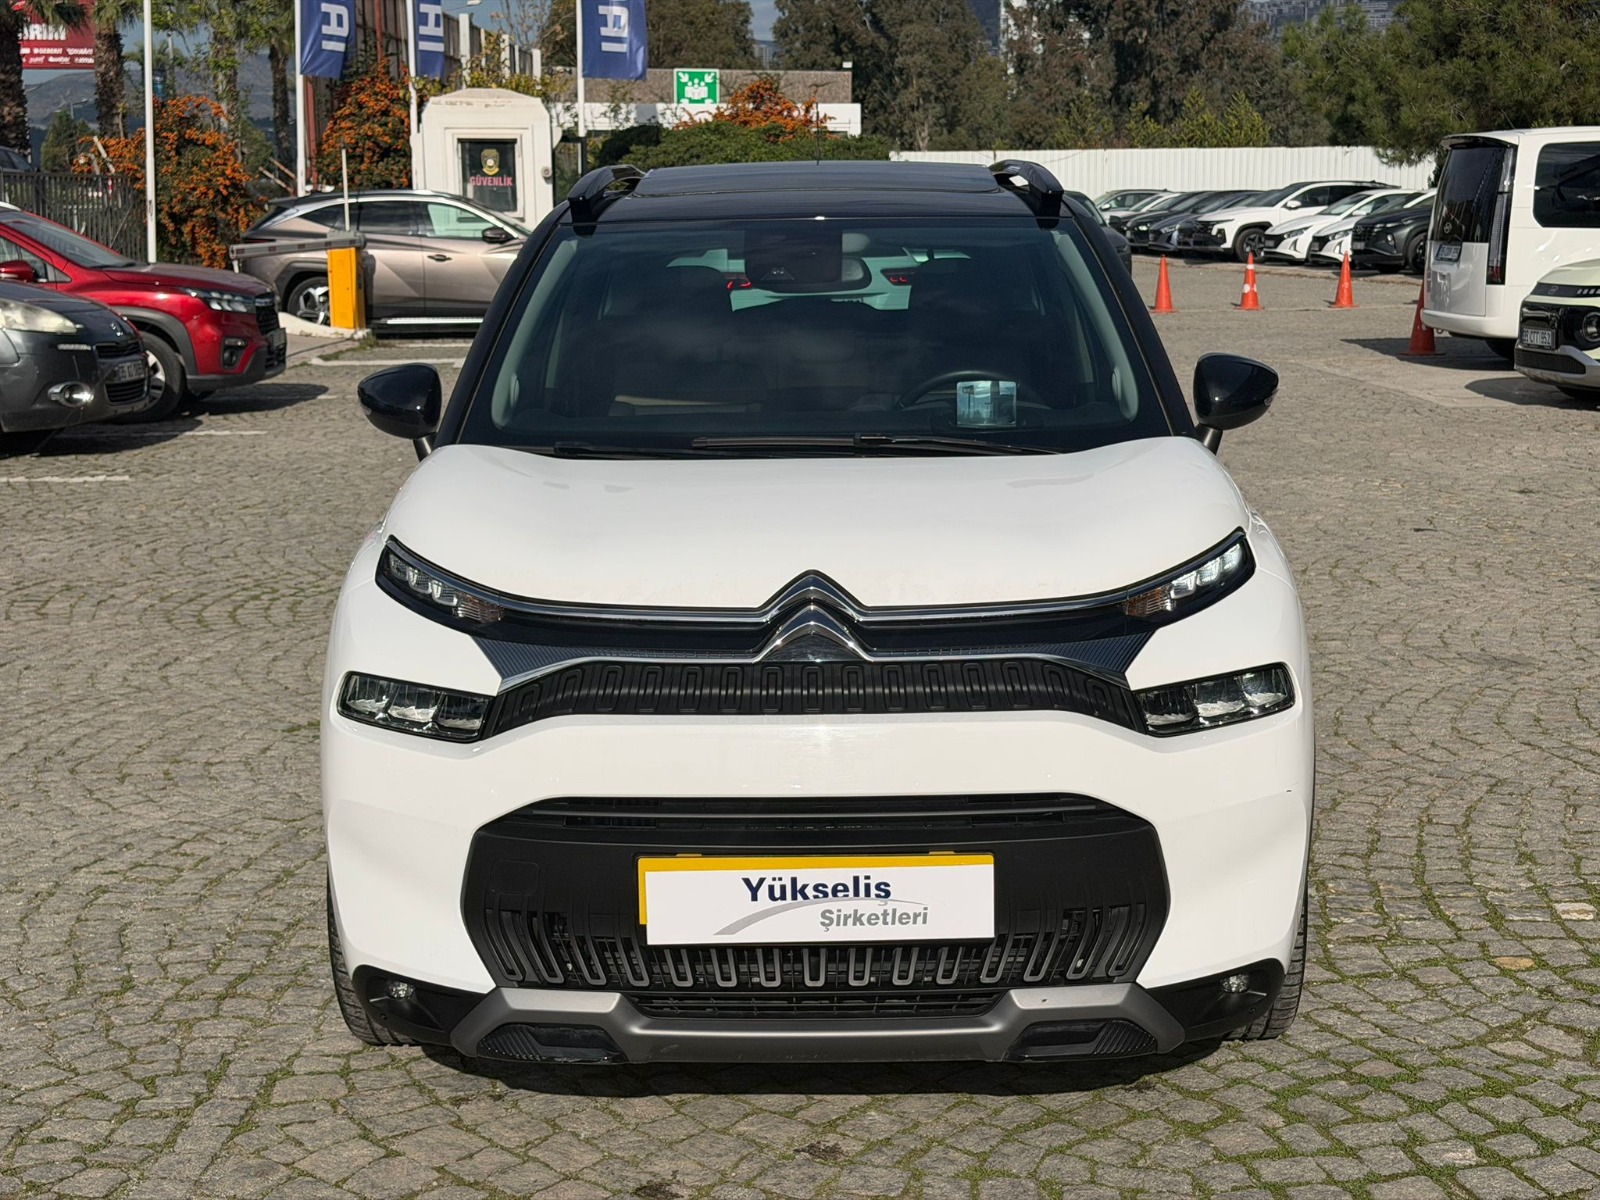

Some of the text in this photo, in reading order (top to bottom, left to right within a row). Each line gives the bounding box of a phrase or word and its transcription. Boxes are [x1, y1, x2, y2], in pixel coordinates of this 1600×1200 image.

[470, 175, 513, 187] GÜVENLİK
[741, 874, 892, 907] Yükseliş
[819, 906, 929, 933] Şirketleri
